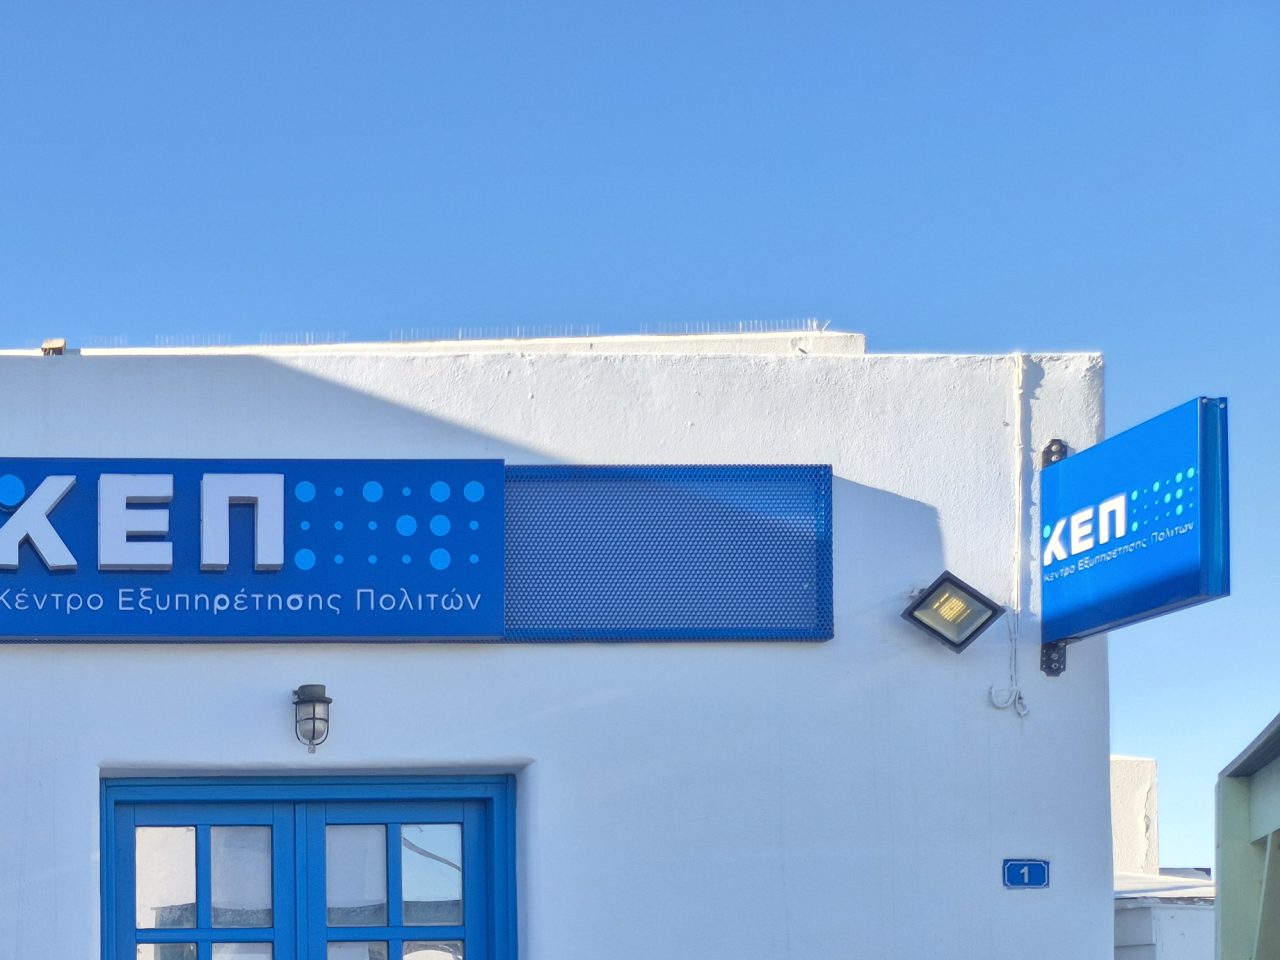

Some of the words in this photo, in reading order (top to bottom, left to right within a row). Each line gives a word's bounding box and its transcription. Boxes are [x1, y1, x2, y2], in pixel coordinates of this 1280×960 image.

[1043, 493, 1127, 567] ΚΕΠ
[118, 588, 342, 615] Εξυπηρέτησης
[356, 588, 482, 612] Πολιτών
[1019, 865, 1029, 883] 1
